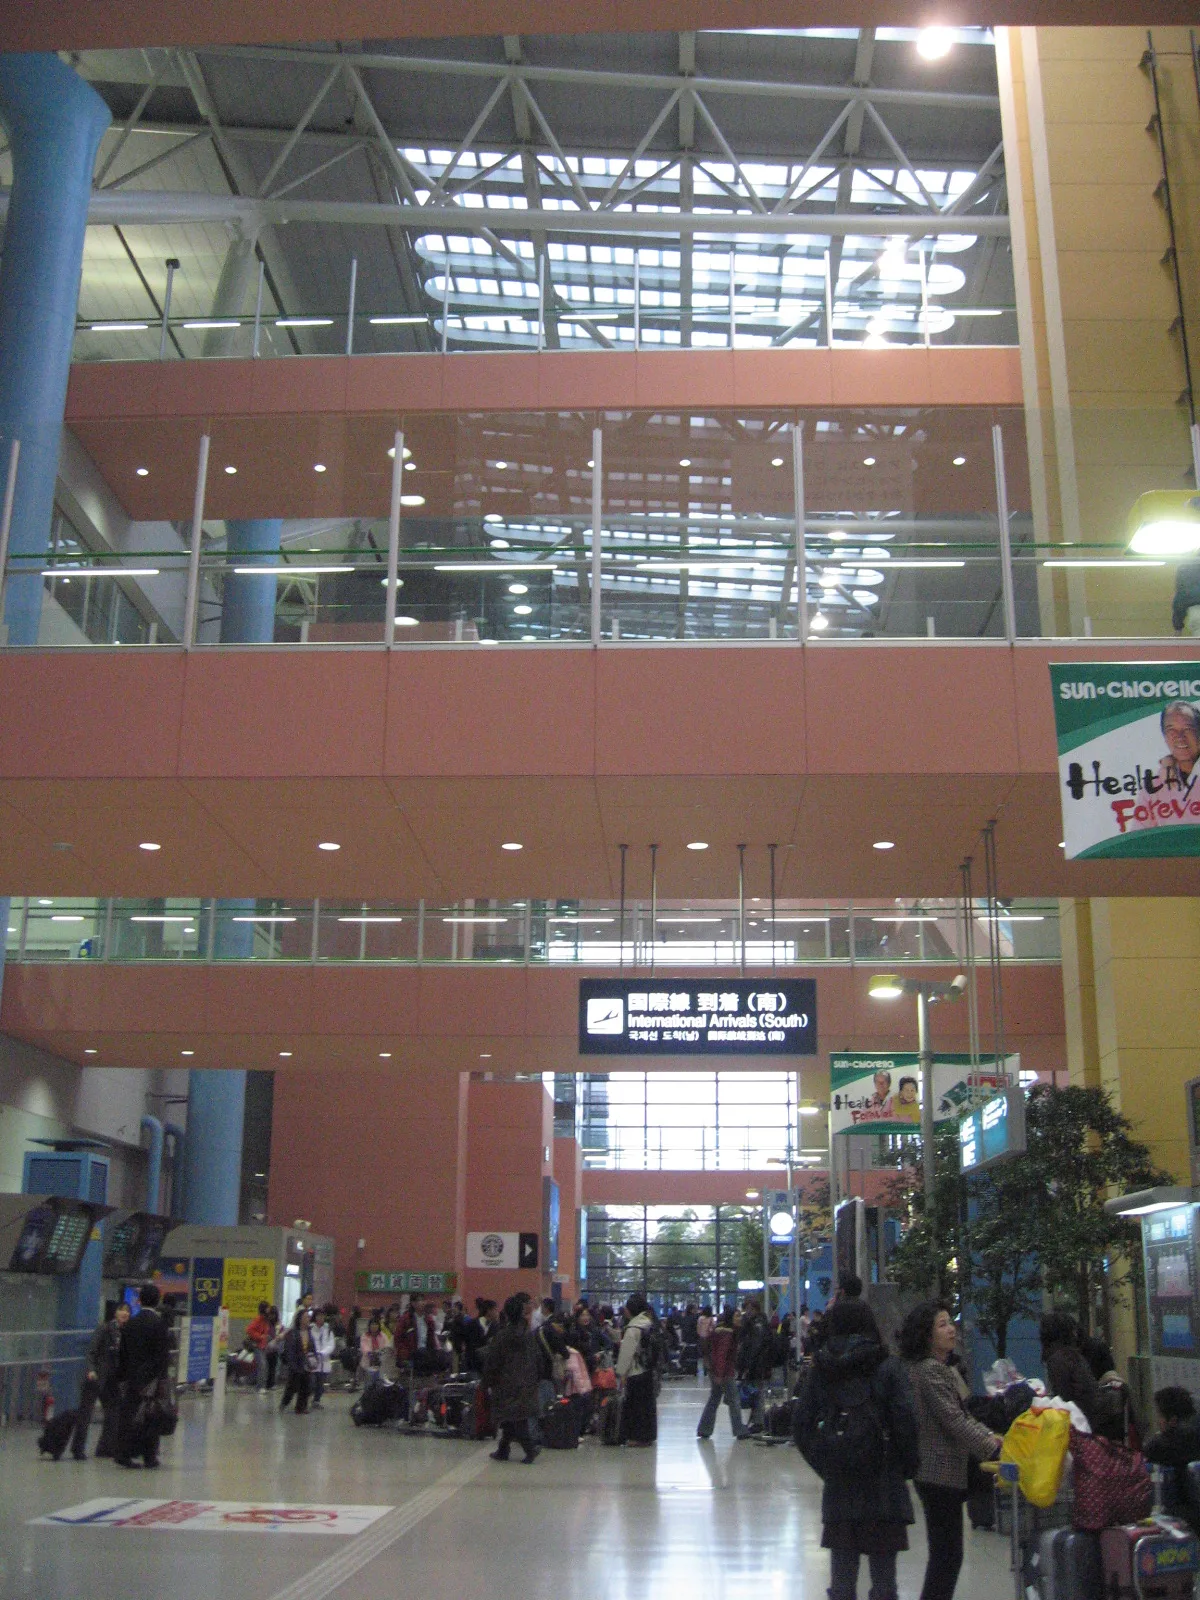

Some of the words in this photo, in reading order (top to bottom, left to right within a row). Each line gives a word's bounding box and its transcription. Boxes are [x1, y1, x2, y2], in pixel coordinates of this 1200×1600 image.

[1066, 760, 1198, 801] Healthy
[627, 993, 691, 1012] 国際線
[697, 992, 740, 1012] 到着
[627, 1013, 707, 1028] International
[709, 1013, 758, 1028] Arrivals
[758, 1013, 808, 1029] (South)
